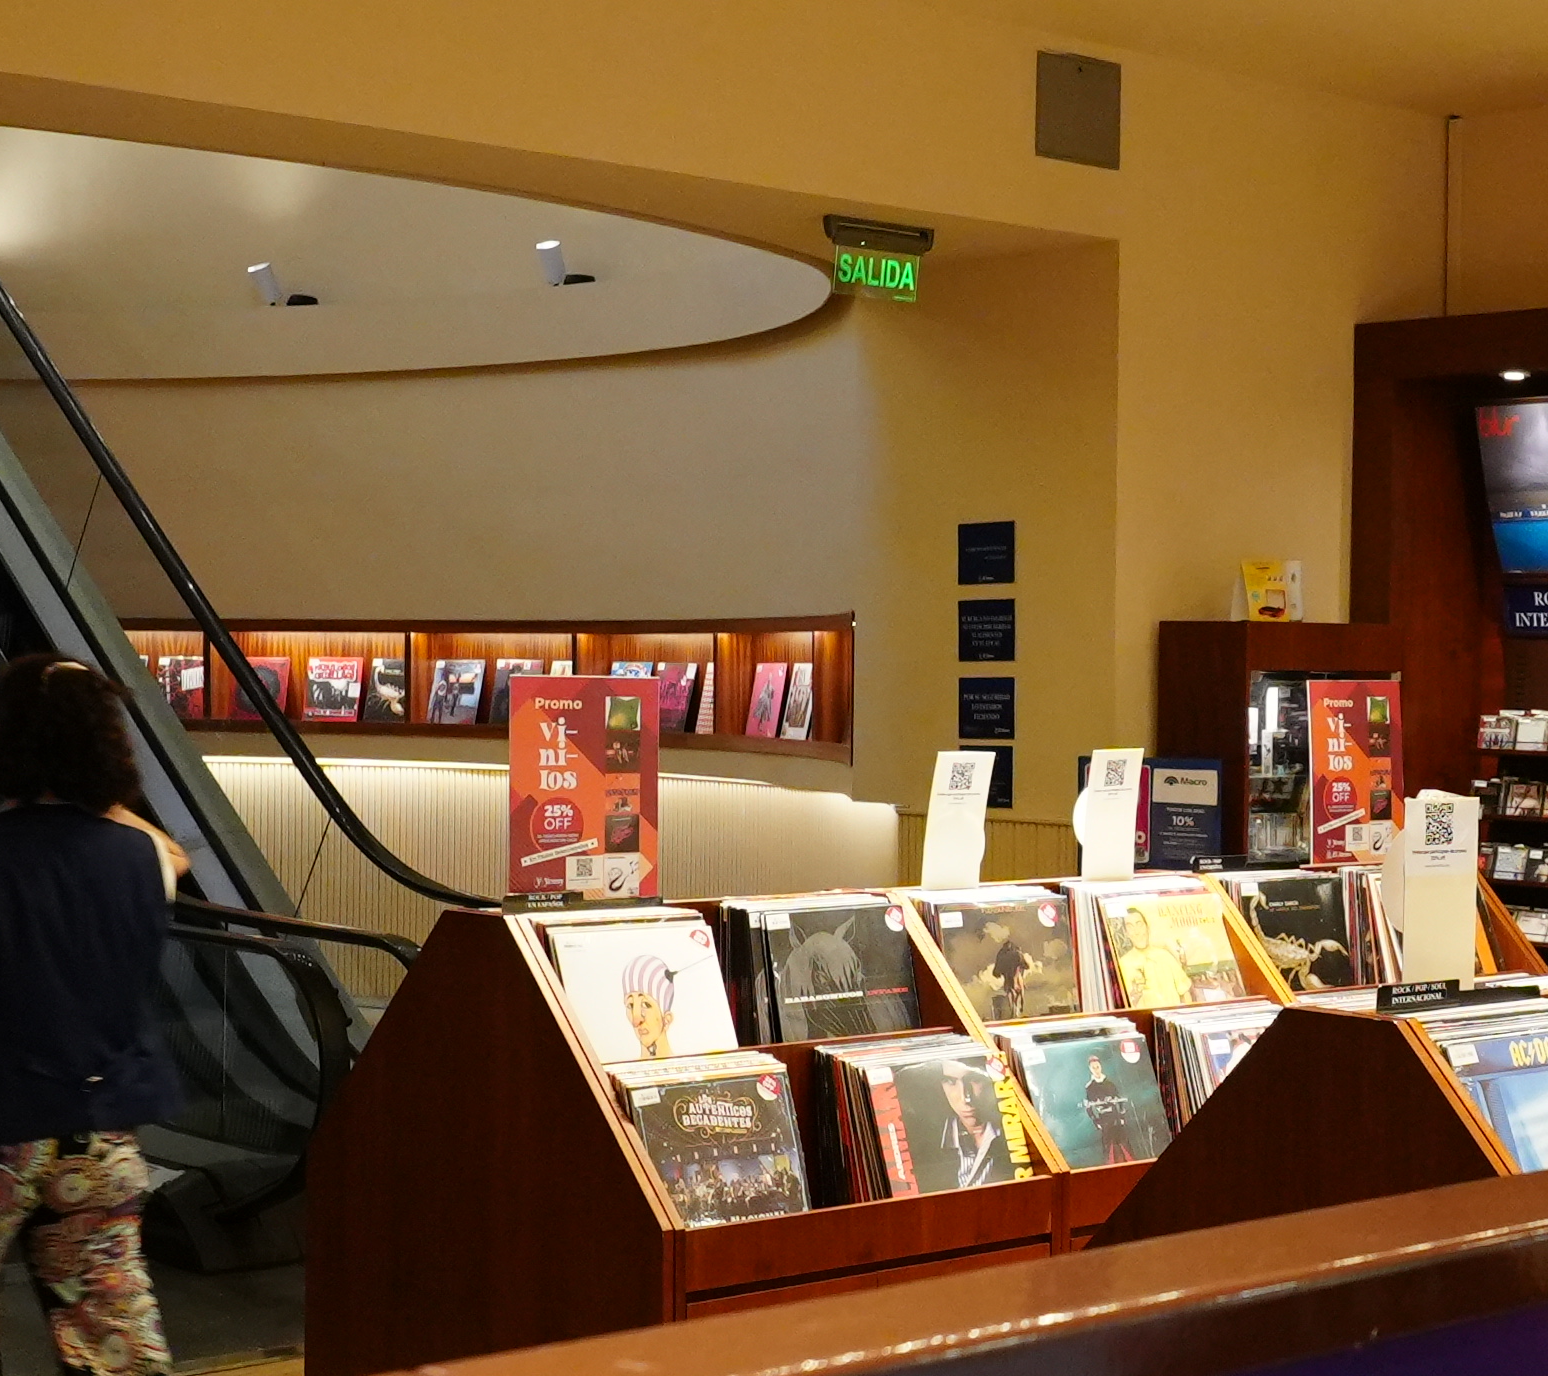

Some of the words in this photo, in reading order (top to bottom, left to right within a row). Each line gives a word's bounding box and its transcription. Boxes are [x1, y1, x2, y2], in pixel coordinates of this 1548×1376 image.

[838, 253, 915, 291] SALIDA
[1479, 406, 1520, 437] blur
[535, 697, 582, 709] Promo
[1324, 698, 1353, 708] Promo
[1181, 777, 1207, 786] Macro
[1332, 782, 1350, 792] 25%
[1332, 793, 1350, 802] OFF
[544, 805, 573, 817] 25%
[544, 818, 572, 830] OFF
[1172, 815, 1194, 826] 10%
[1393, 985, 1412, 995] ROCK
[1415, 984, 1428, 994] POP
[1431, 982, 1447, 991] SOUL
[1392, 993, 1444, 1006] INTERNACIONAL
